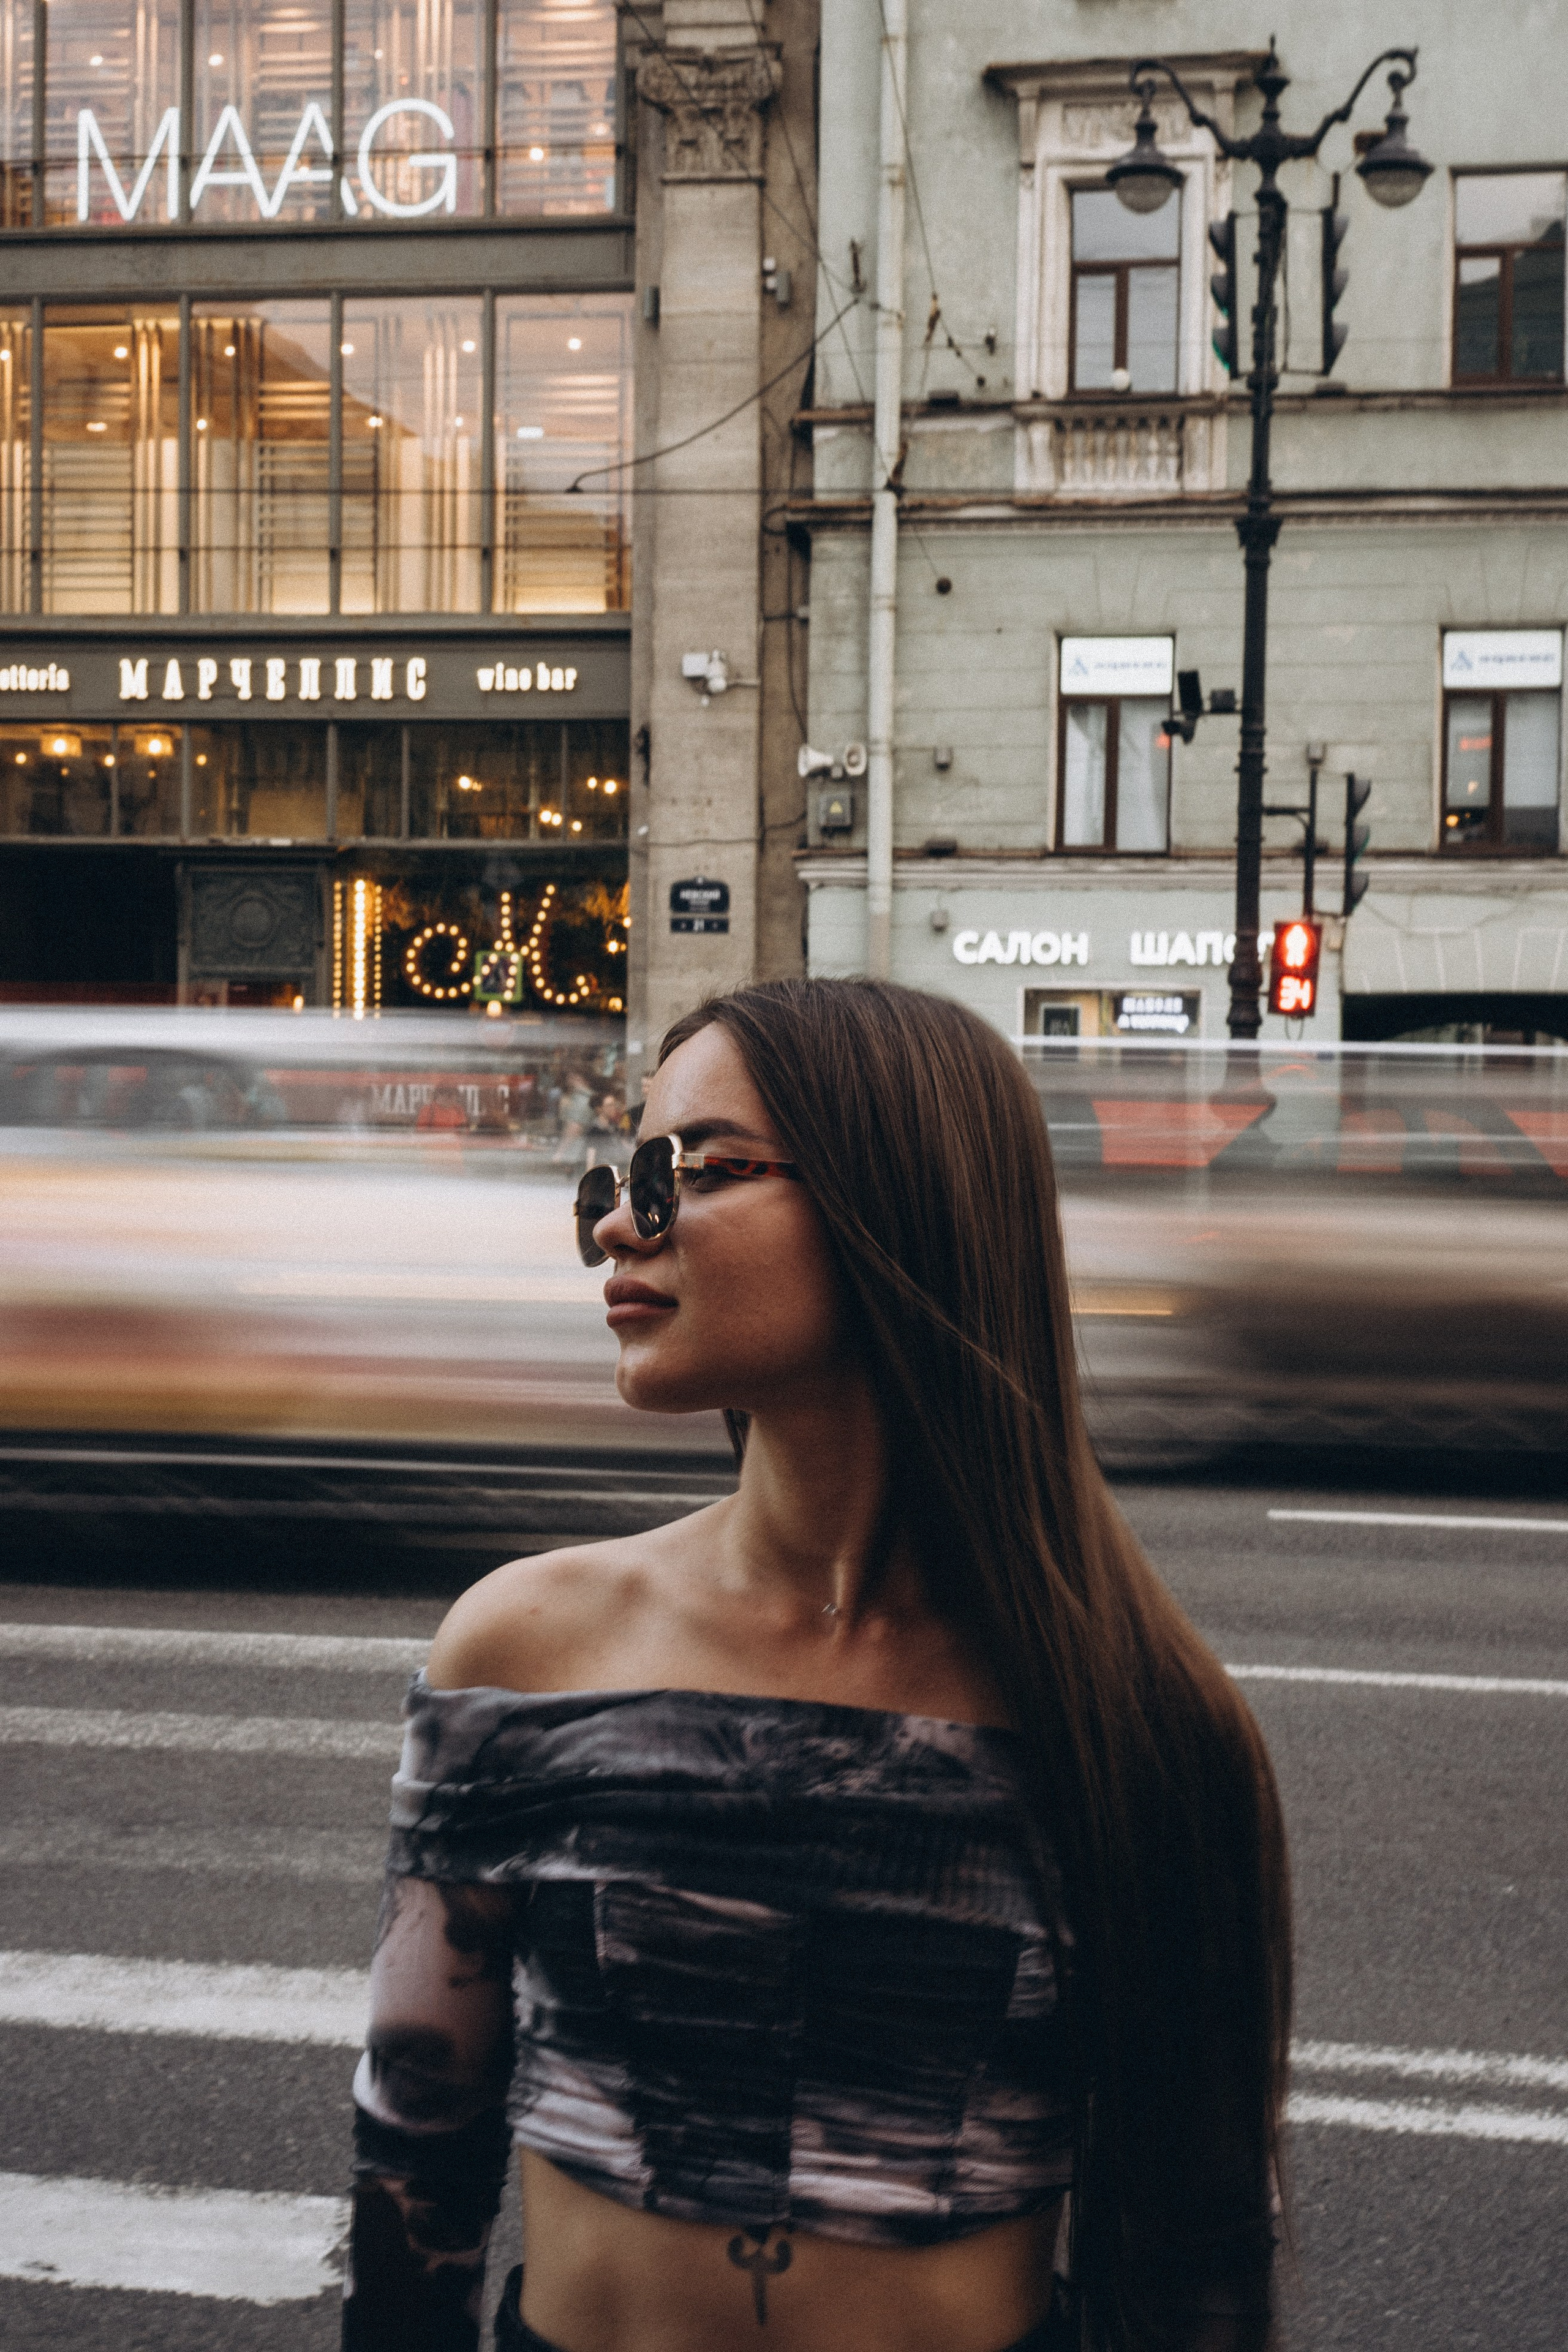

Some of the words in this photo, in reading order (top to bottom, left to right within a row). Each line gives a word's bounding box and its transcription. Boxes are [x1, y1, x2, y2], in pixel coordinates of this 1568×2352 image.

[77, 97, 457, 221] MAAG
[537, 662, 577, 690] bar
[953, 930, 1088, 965] САЛОН
[1279, 976, 1311, 1011] 34
